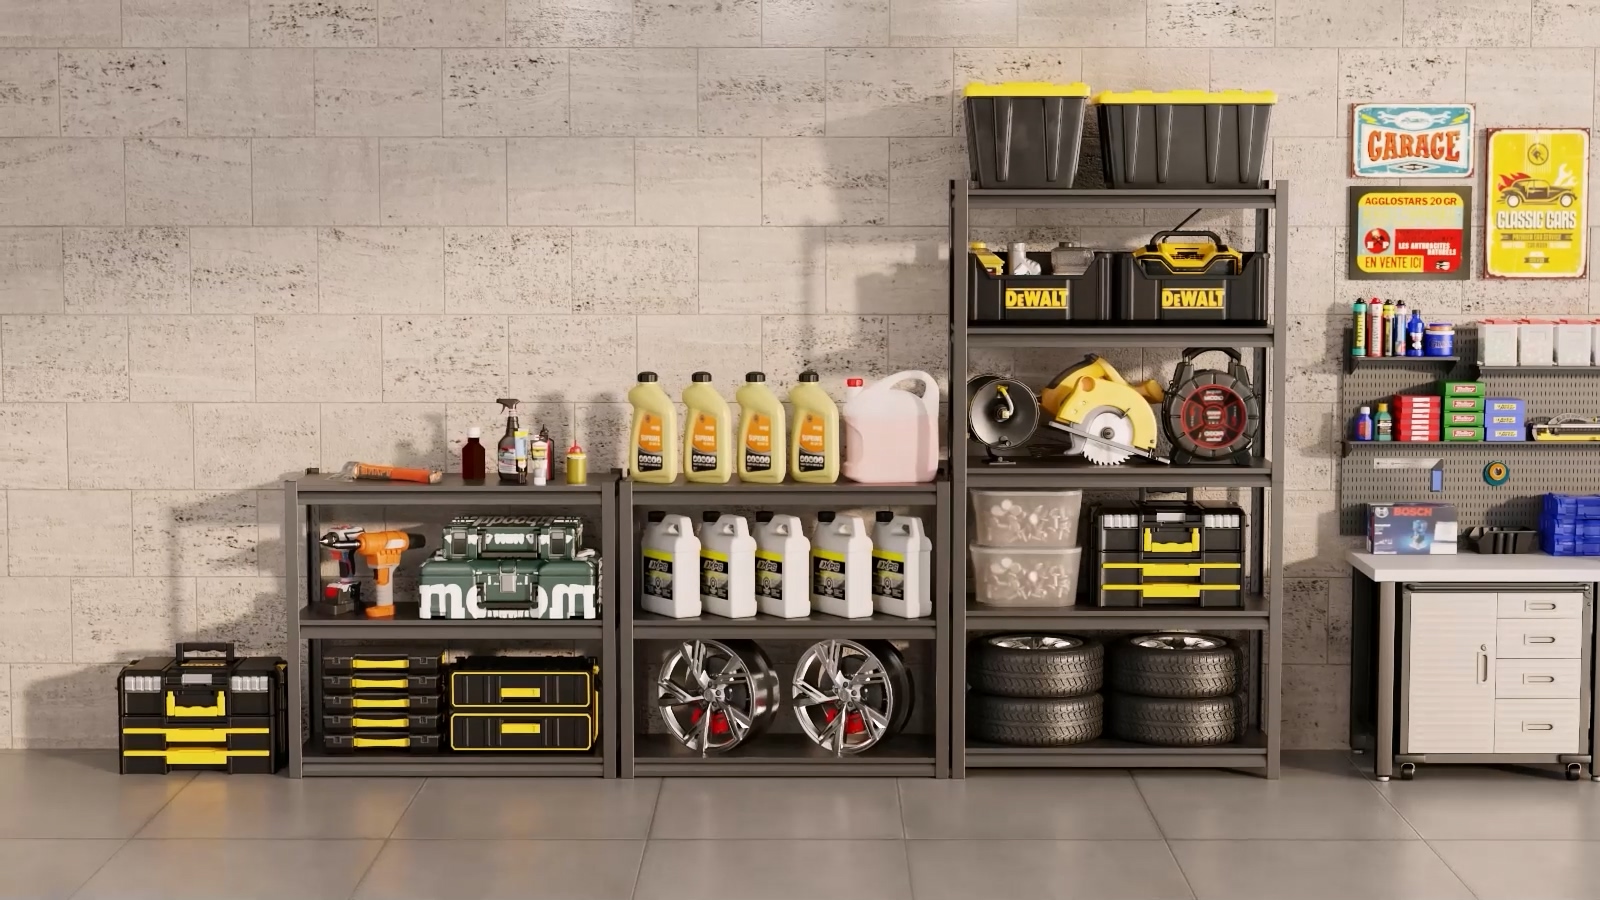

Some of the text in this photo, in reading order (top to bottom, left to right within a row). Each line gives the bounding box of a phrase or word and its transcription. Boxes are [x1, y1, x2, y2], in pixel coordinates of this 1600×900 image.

[1368, 130, 1461, 162] GARAGE
[1365, 197, 1457, 206] AGGLOSTARS 20 GR
[1496, 211, 1577, 230] CLASSIC CARS
[1398, 242, 1410, 250] LES
[1365, 257, 1422, 269] EN VENTE ICI
[1392, 507, 1432, 517] BOSCH
